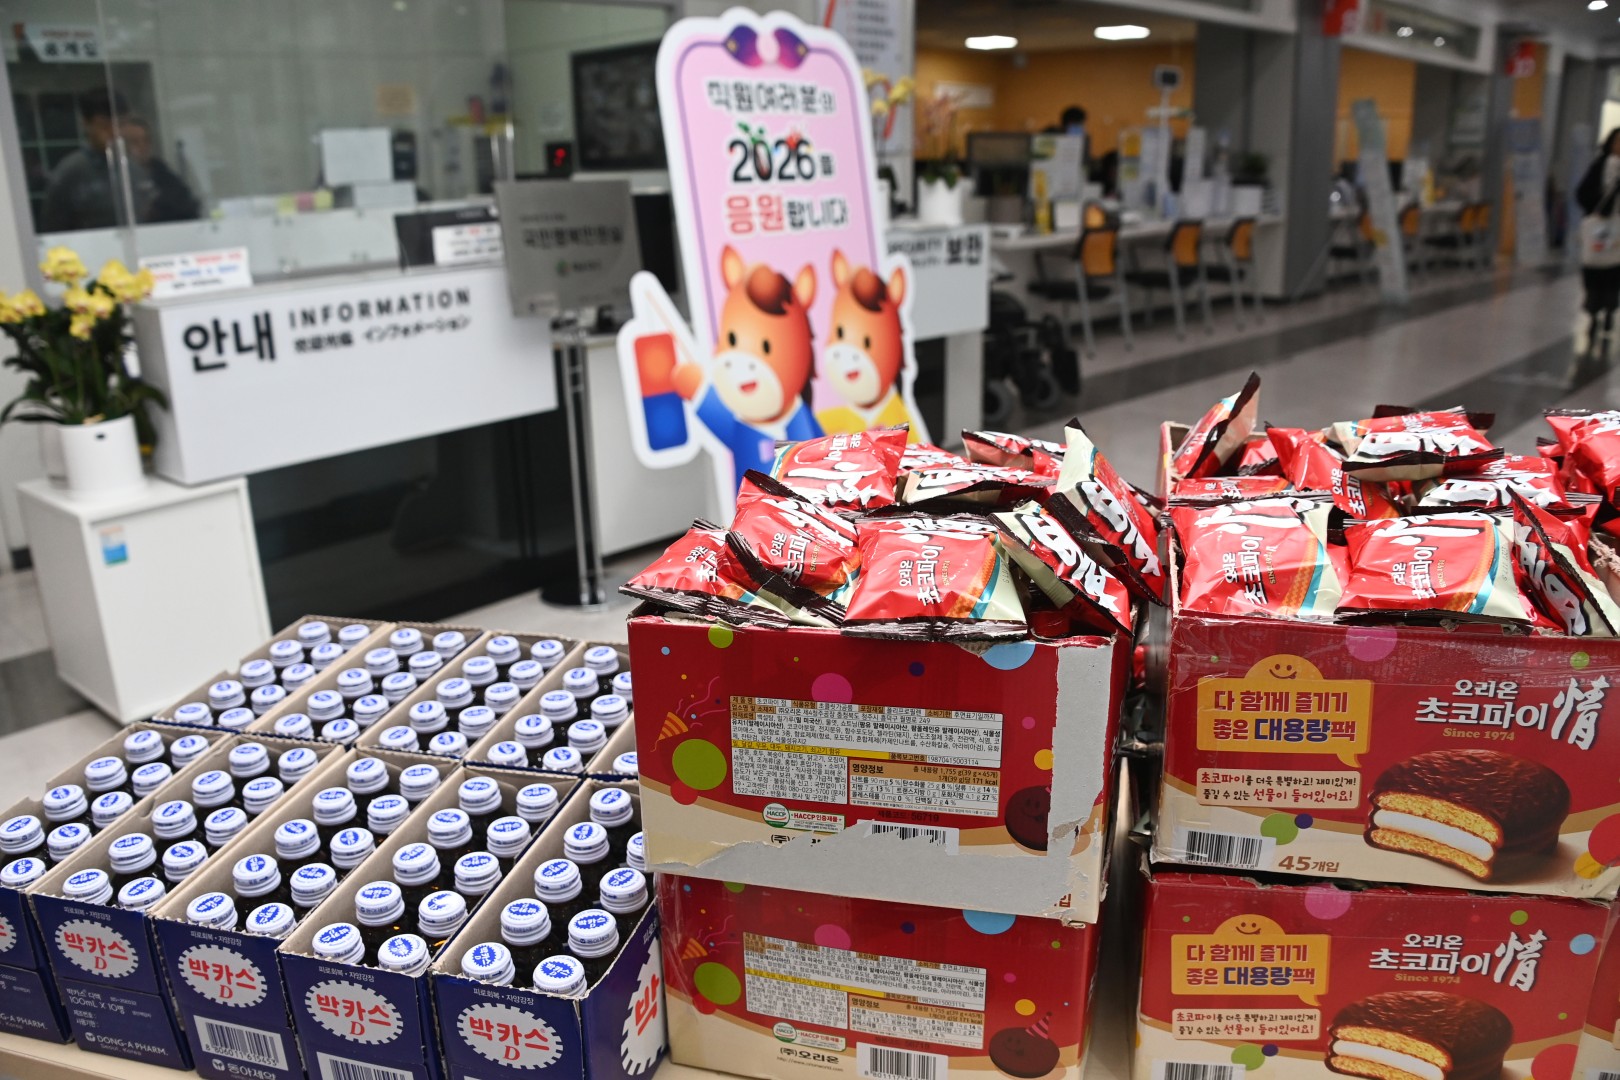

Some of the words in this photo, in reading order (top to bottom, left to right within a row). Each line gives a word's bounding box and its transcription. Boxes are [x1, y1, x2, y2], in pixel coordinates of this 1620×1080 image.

[289, 289, 472, 328] INFORMATION
[183, 311, 277, 372] 안내
[1332, 468, 1343, 496] 오리온
[684, 545, 709, 563] 오리온
[771, 532, 788, 557] 오리온
[899, 560, 914, 587] 오리온
[916, 545, 944, 606] 초코파이
[1223, 553, 1238, 583] 오리온
[1238, 536, 1269, 605] 초코파이
[1407, 546, 1439, 600] 초코파이
[1452, 679, 1519, 700] 오리온
[1215, 690, 1236, 712] 다
[1240, 691, 1291, 713] 함께
[1295, 691, 1348, 713] 즐기기
[1414, 697, 1549, 731] 초코파이
[1551, 675, 1611, 750] 情
[1213, 719, 1249, 740] 좋은
[1255, 718, 1357, 742] 대용량팩
[1442, 728, 1481, 739] Since
[1484, 731, 1515, 741] 1974
[851, 762, 884, 775] 영양정보
[1201, 772, 1252, 786] 초코파이를
[1256, 776, 1274, 786] 더욱
[1276, 775, 1314, 787] 특별하고!
[1316, 777, 1357, 788] 재미있게!
[1203, 789, 1220, 800] 즐길
[1222, 790, 1231, 799] 수
[1233, 790, 1250, 801] 있는
[1253, 789, 1288, 803] 선물이
[1292, 790, 1353, 803] 들어있어요!
[1278, 854, 1340, 873] 45개입
[64, 932, 129, 961] 박카스
[1402, 934, 1464, 951] 오리온
[1187, 944, 1206, 962] 다
[1210, 944, 1255, 962] 함께
[1260, 944, 1308, 962] 즐기기
[1368, 948, 1491, 976] 초코파이
[1493, 929, 1548, 992] 情
[95, 956, 107, 970] D
[188, 958, 257, 990] 박카스
[318, 966, 344, 977] 피로회복
[348, 971, 375, 983] 자양강장
[1187, 968, 1218, 985] 좋은
[1223, 967, 1316, 986] 대용량팩
[1394, 973, 1429, 983] Since
[1432, 975, 1461, 985] 1974
[219, 985, 233, 999] D
[473, 988, 500, 999] 피로회복
[506, 994, 535, 1006] 자양강장
[316, 994, 392, 1027] 박카스
[851, 996, 879, 1009] 영양정보
[16, 1016, 49, 1030] PHARM.
[1176, 1012, 1223, 1022] 초코파이를
[350, 1021, 365, 1036] D
[469, 1016, 550, 1051] 박카스
[1205, 1026, 1221, 1035] 있는
[1223, 1025, 1255, 1035] 선물이
[1258, 1024, 1314, 1036] 들어있어요!
[97, 1034, 133, 1048] DONG-A
[134, 1042, 168, 1057] PHARM.
[503, 1045, 521, 1061] D
[779, 1046, 840, 1065] (주)오리온
[227, 1062, 276, 1080] 동아제약
